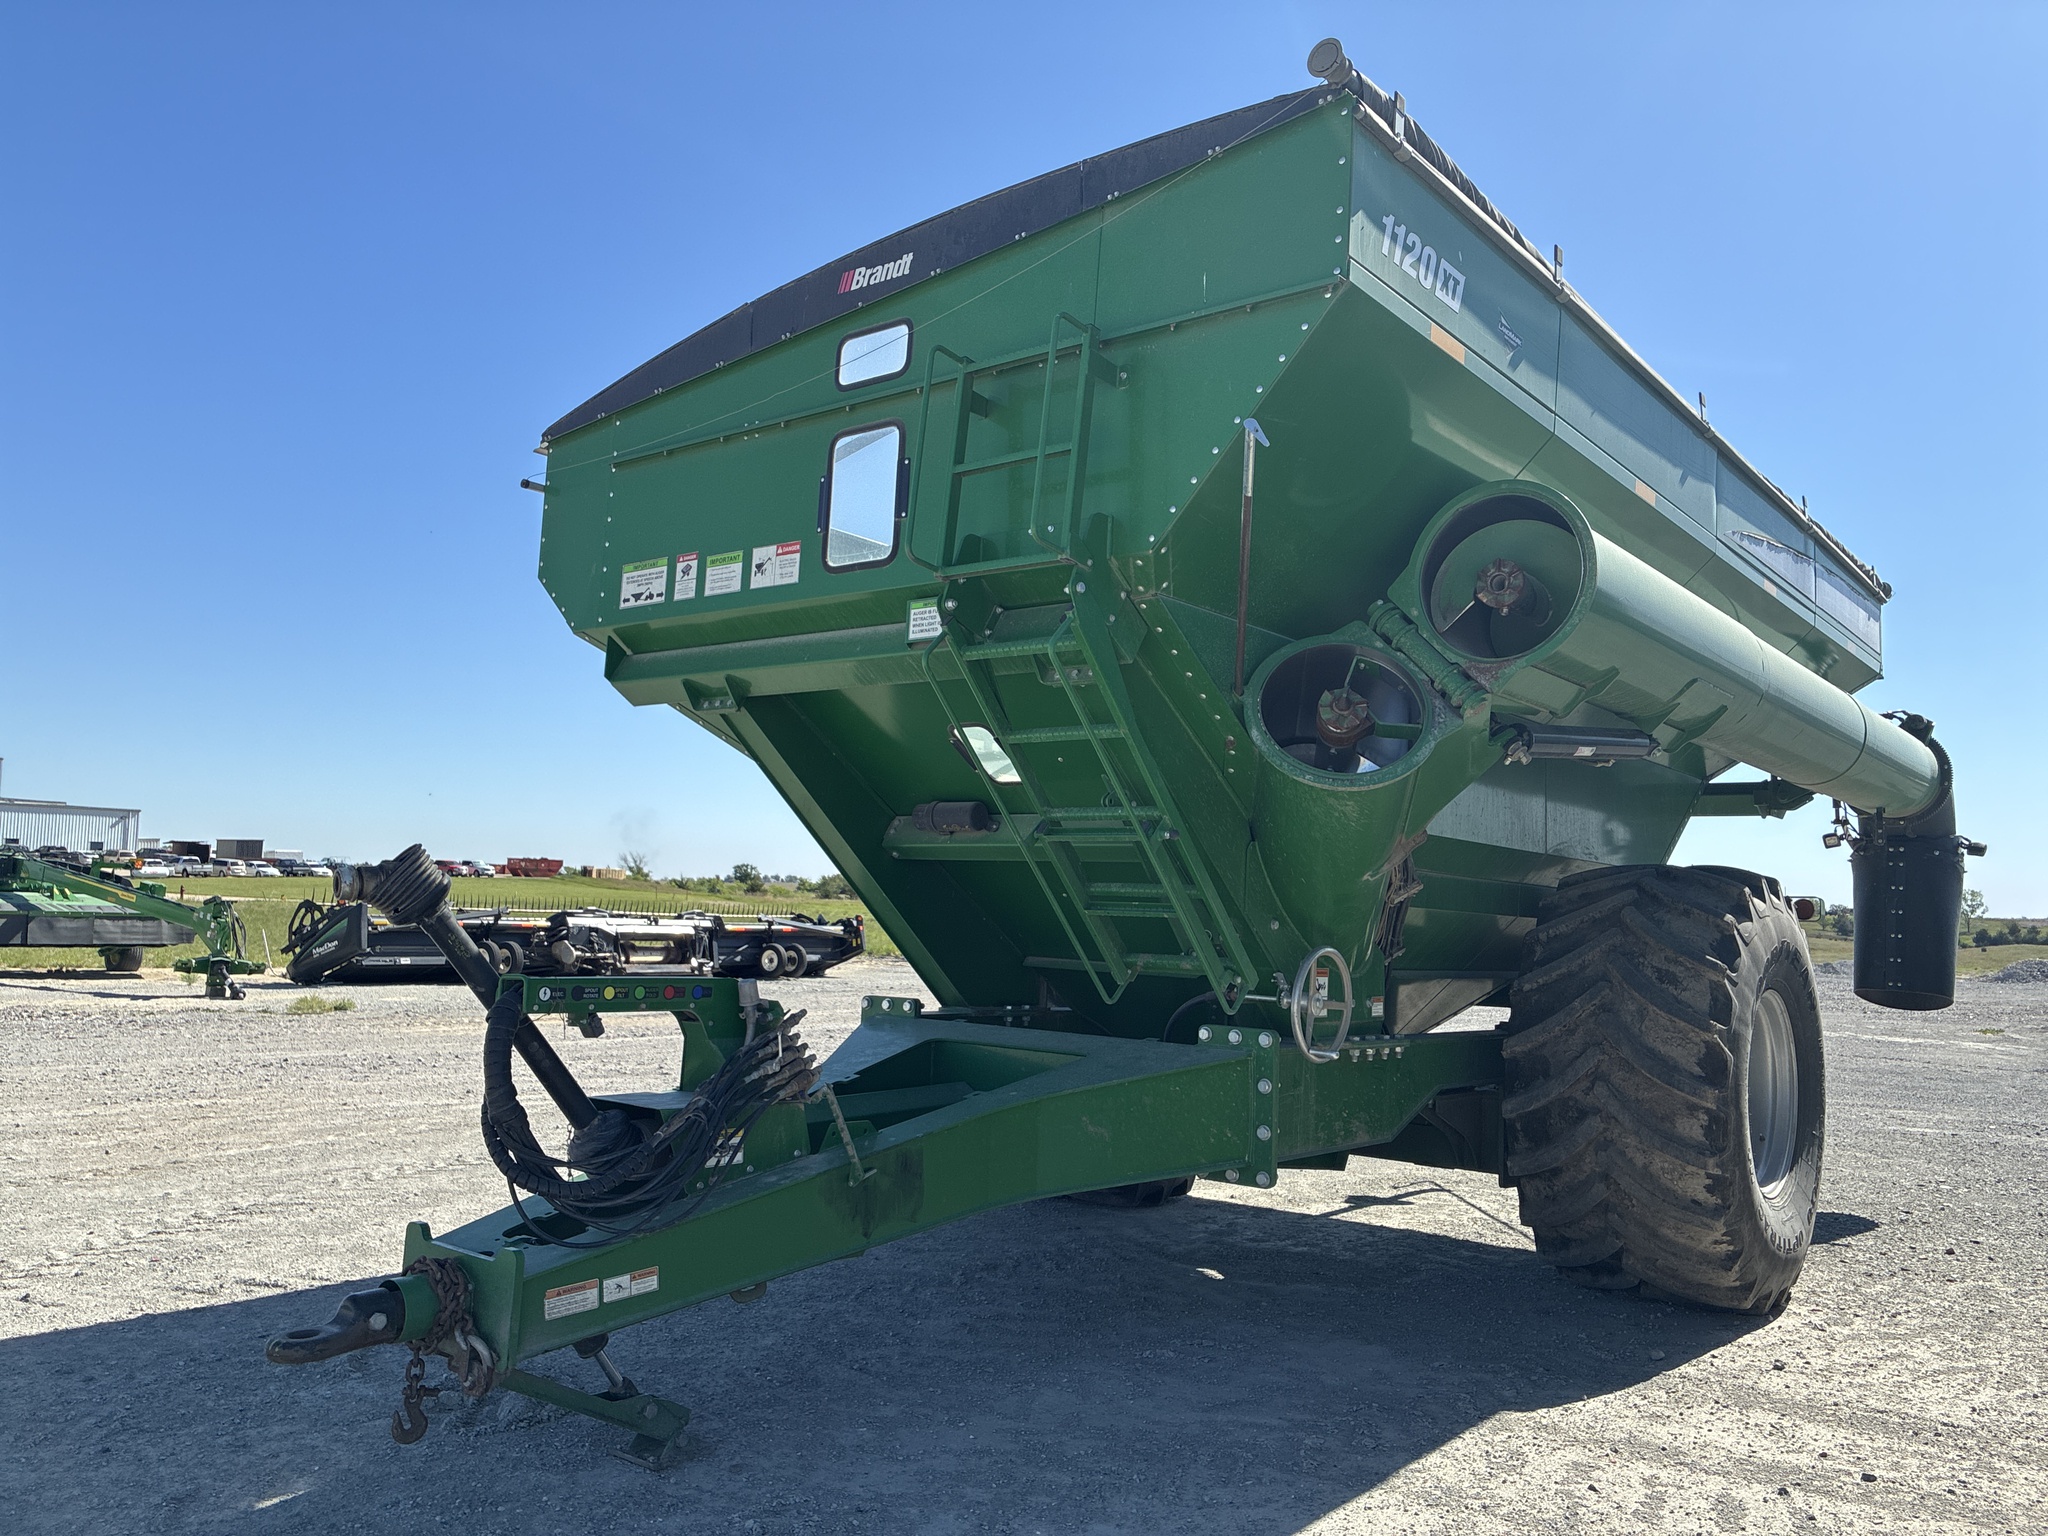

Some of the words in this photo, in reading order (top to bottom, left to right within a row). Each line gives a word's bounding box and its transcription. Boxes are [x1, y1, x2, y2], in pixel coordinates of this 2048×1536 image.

[1381, 214, 1437, 290] 1120
[850, 252, 914, 291] Brandt
[783, 544, 800, 552] DANGER
[709, 555, 741, 565] IMPORTANT
[632, 561, 659, 570] IMPORTANT
[312, 940, 339, 954] MacDon
[637, 1270, 656, 1278] WARNING
[562, 1284, 587, 1295] WARNING
